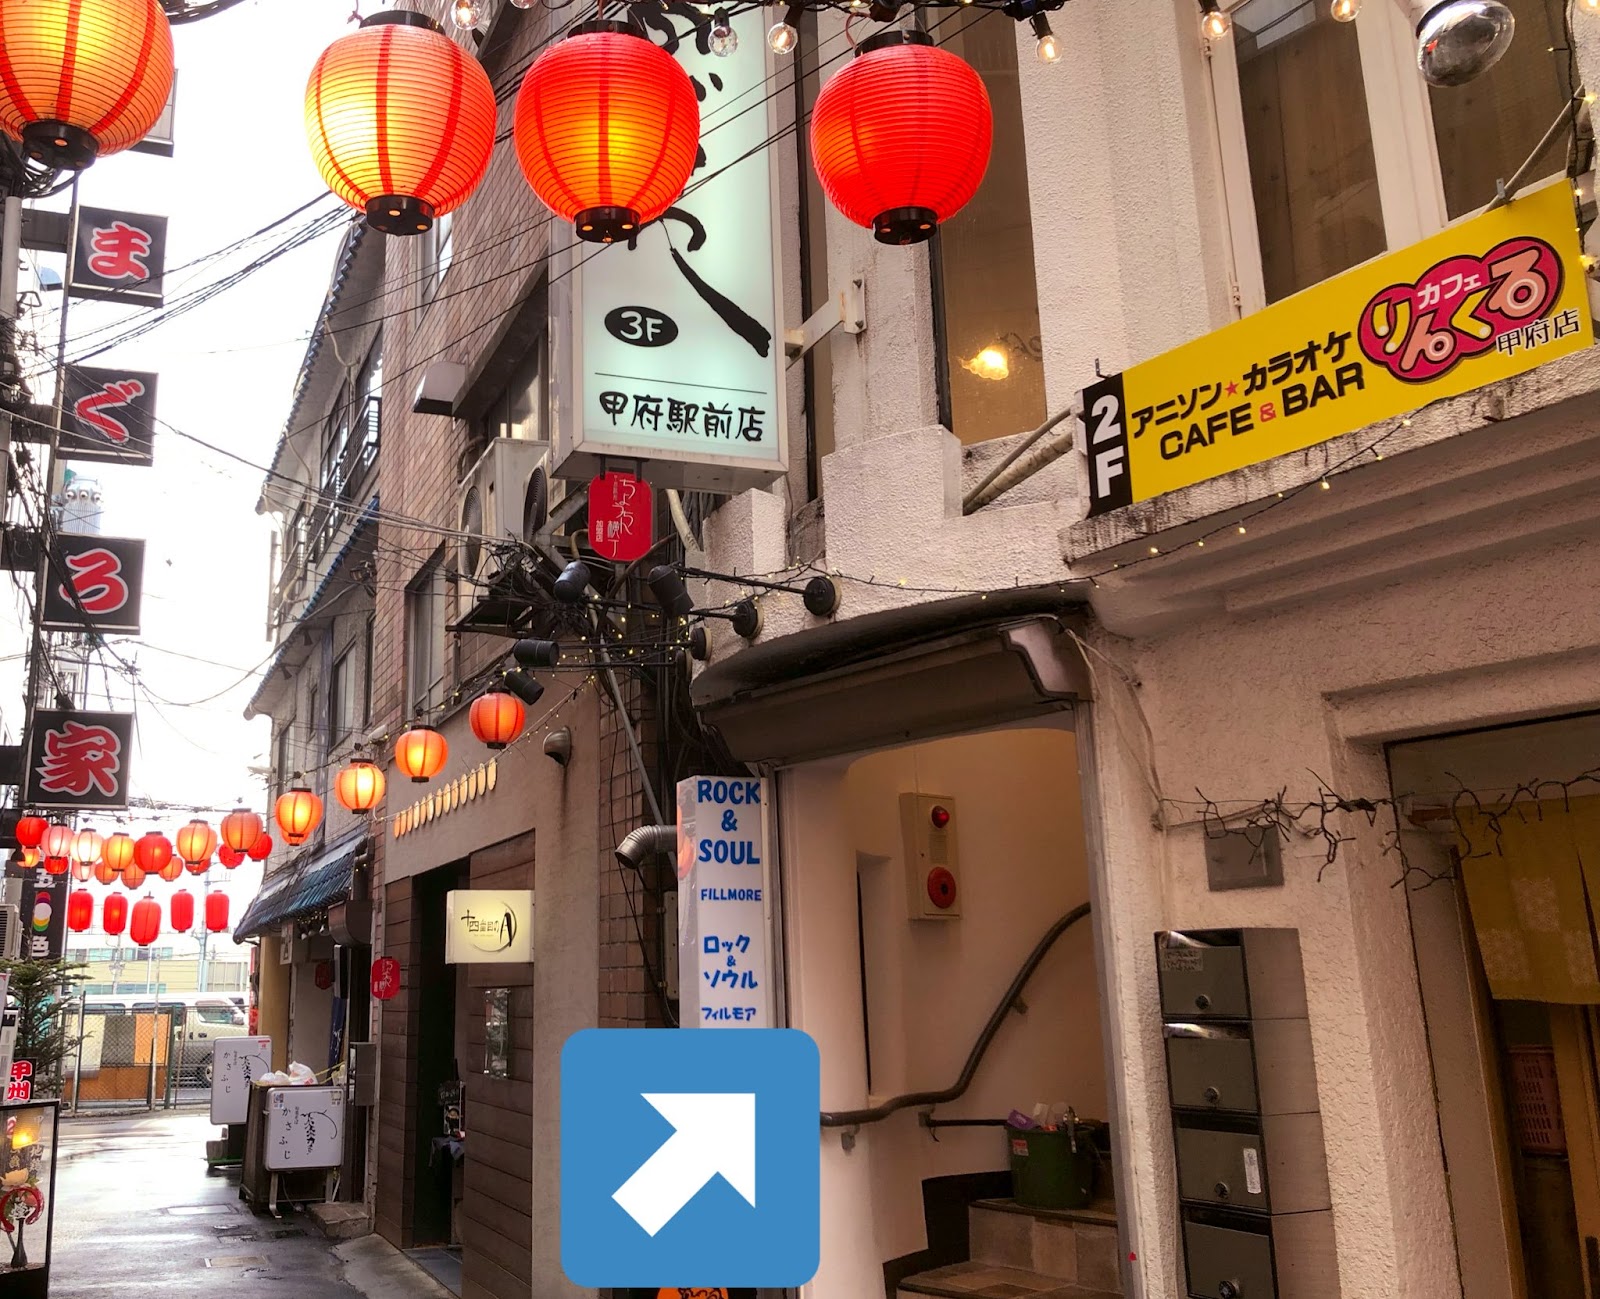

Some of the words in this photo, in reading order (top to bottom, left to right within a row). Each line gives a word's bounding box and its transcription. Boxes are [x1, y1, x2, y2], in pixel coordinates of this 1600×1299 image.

[1417, 273, 1482, 310] カフェ
[1370, 245, 1550, 372] りんくる
[619, 310, 665, 342] 3F
[1496, 308, 1581, 356] 甲府店
[1242, 331, 1352, 397] カラオケ
[599, 390, 766, 442] 甲府駅前店
[1159, 402, 1255, 461] CAFE
[1259, 402, 1276, 423] &
[1281, 361, 1366, 418] BAR
[1091, 394, 1125, 499] 2F
[697, 779, 761, 804] ROCK
[720, 808, 738, 832] &
[698, 838, 760, 865] SOUL
[700, 888, 762, 902] FILLMORE
[703, 934, 751, 954] ロック
[726, 955, 737, 967] &
[703, 969, 759, 990] ソウル
[701, 1006, 757, 1022] フィルモア
[279, 1108, 292, 1160] かさふじ
